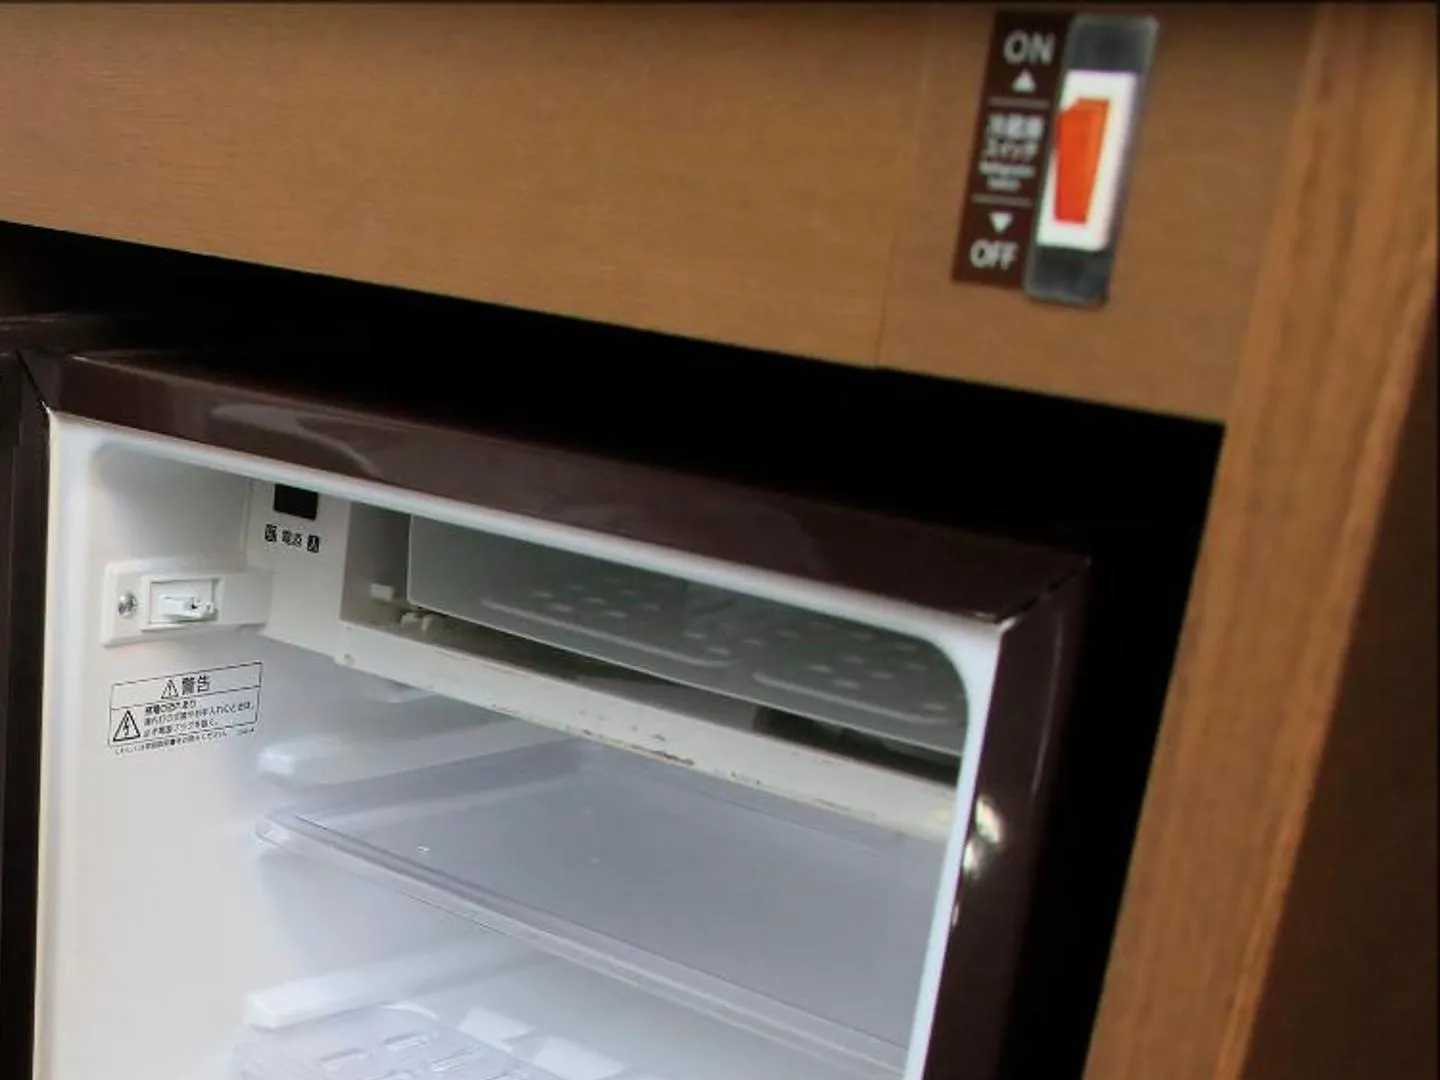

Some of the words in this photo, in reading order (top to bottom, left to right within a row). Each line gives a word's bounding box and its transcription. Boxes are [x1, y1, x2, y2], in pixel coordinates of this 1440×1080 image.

[1004, 30, 1054, 66] ON
[969, 238, 1017, 270] OFF
[181, 675, 210, 695] 警告
